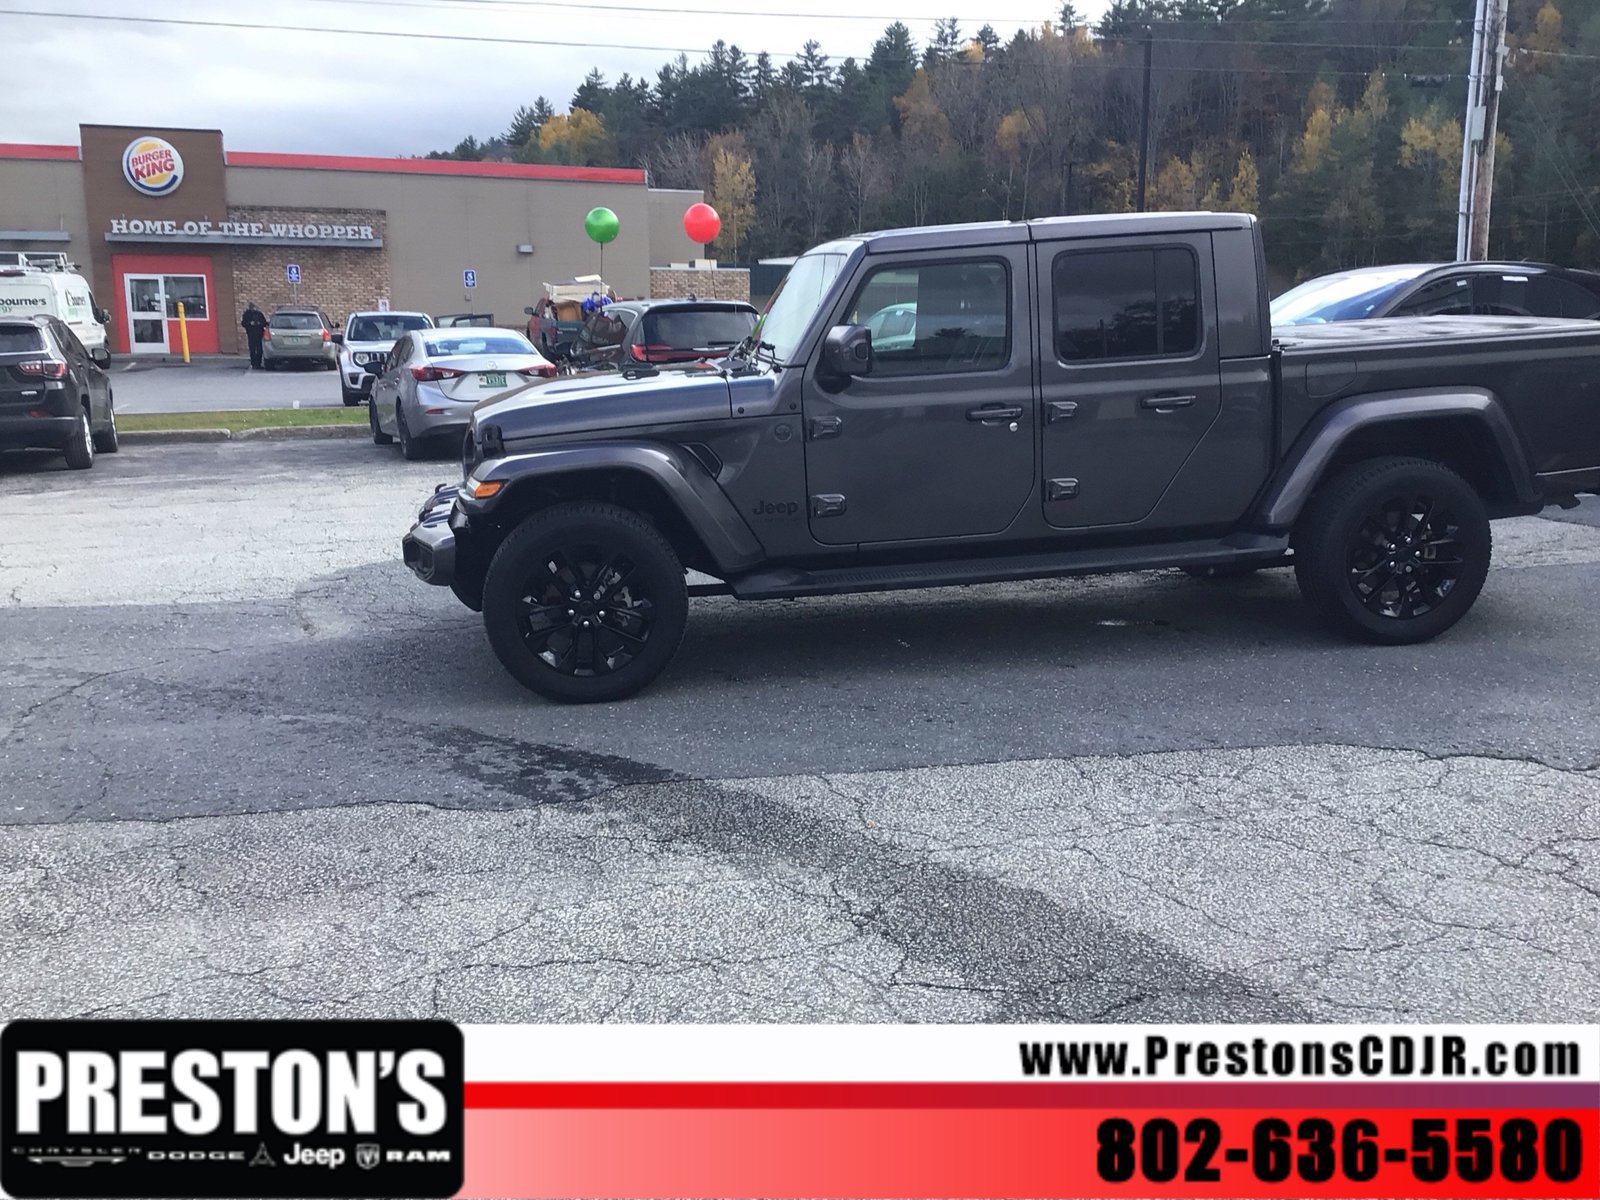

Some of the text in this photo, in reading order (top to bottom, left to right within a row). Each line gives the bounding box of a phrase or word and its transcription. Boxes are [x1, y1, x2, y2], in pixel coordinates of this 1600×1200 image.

[131, 149, 172, 167] BURGER
[134, 159, 175, 180] KING
[110, 219, 375, 240] HOME OF THE WHOPPER
[752, 500, 799, 516] Jeep
